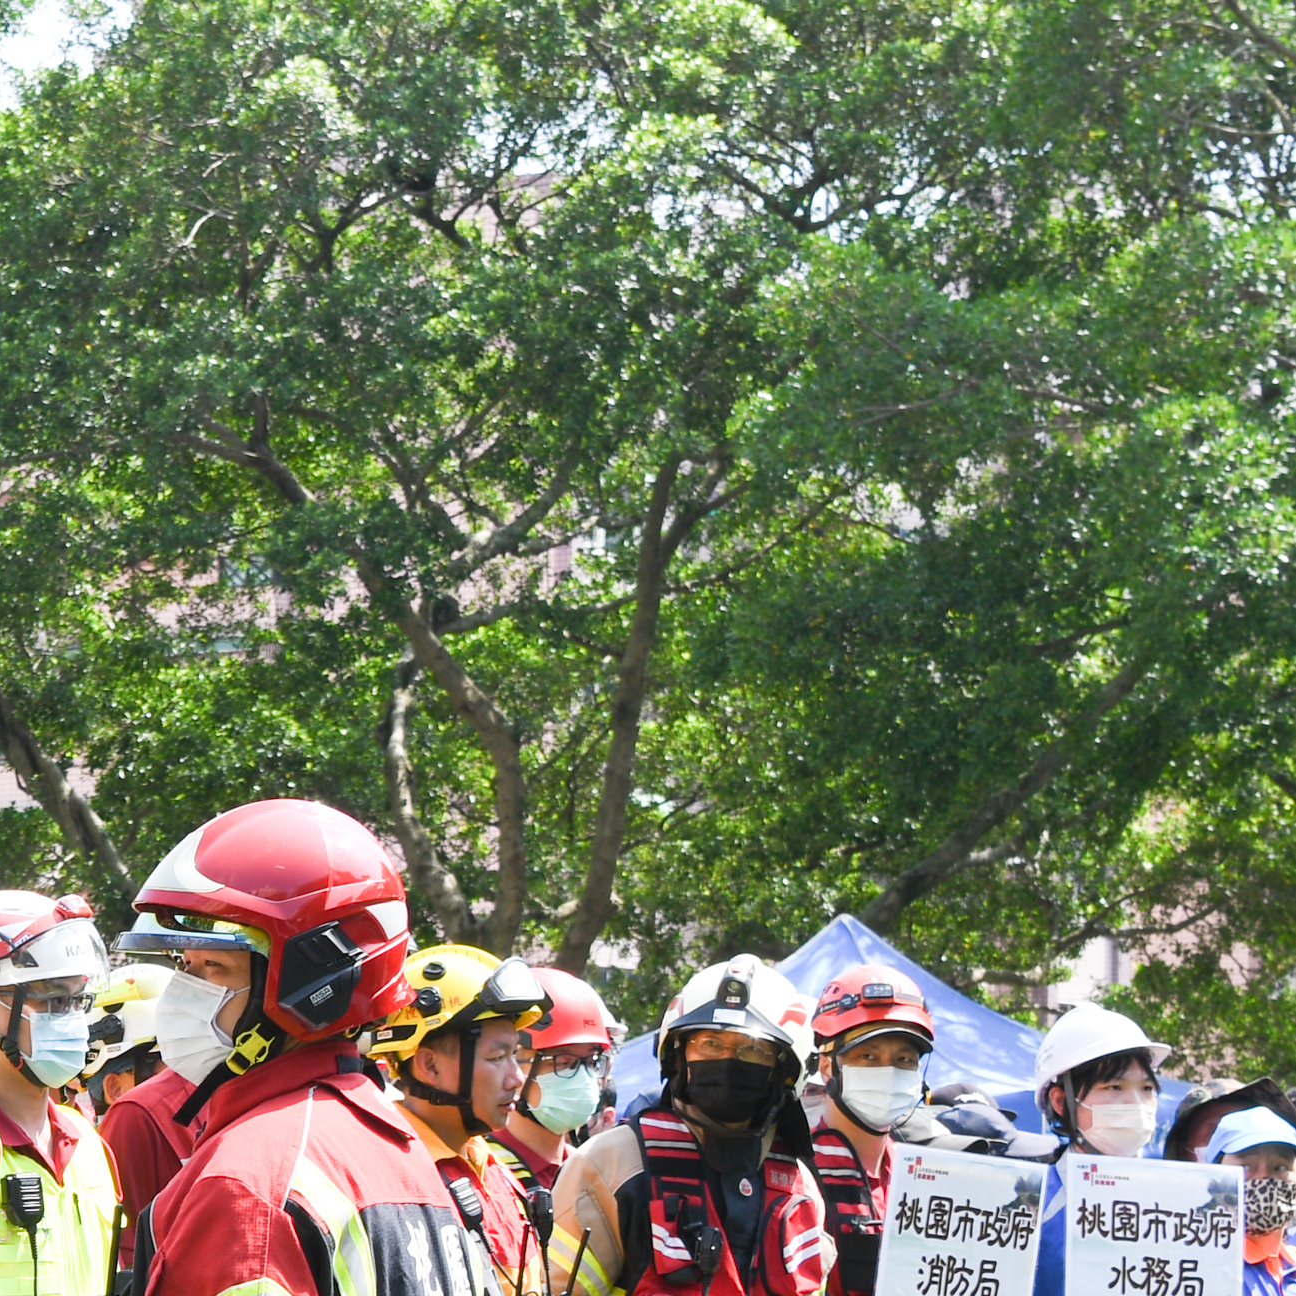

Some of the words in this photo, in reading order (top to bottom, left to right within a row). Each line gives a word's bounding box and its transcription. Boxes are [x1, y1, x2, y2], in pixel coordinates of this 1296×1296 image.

[311, 986, 331, 1003] MSA
[895, 1192, 1035, 1250] 桃園市政府
[1076, 1198, 1236, 1249] 桃園市政府
